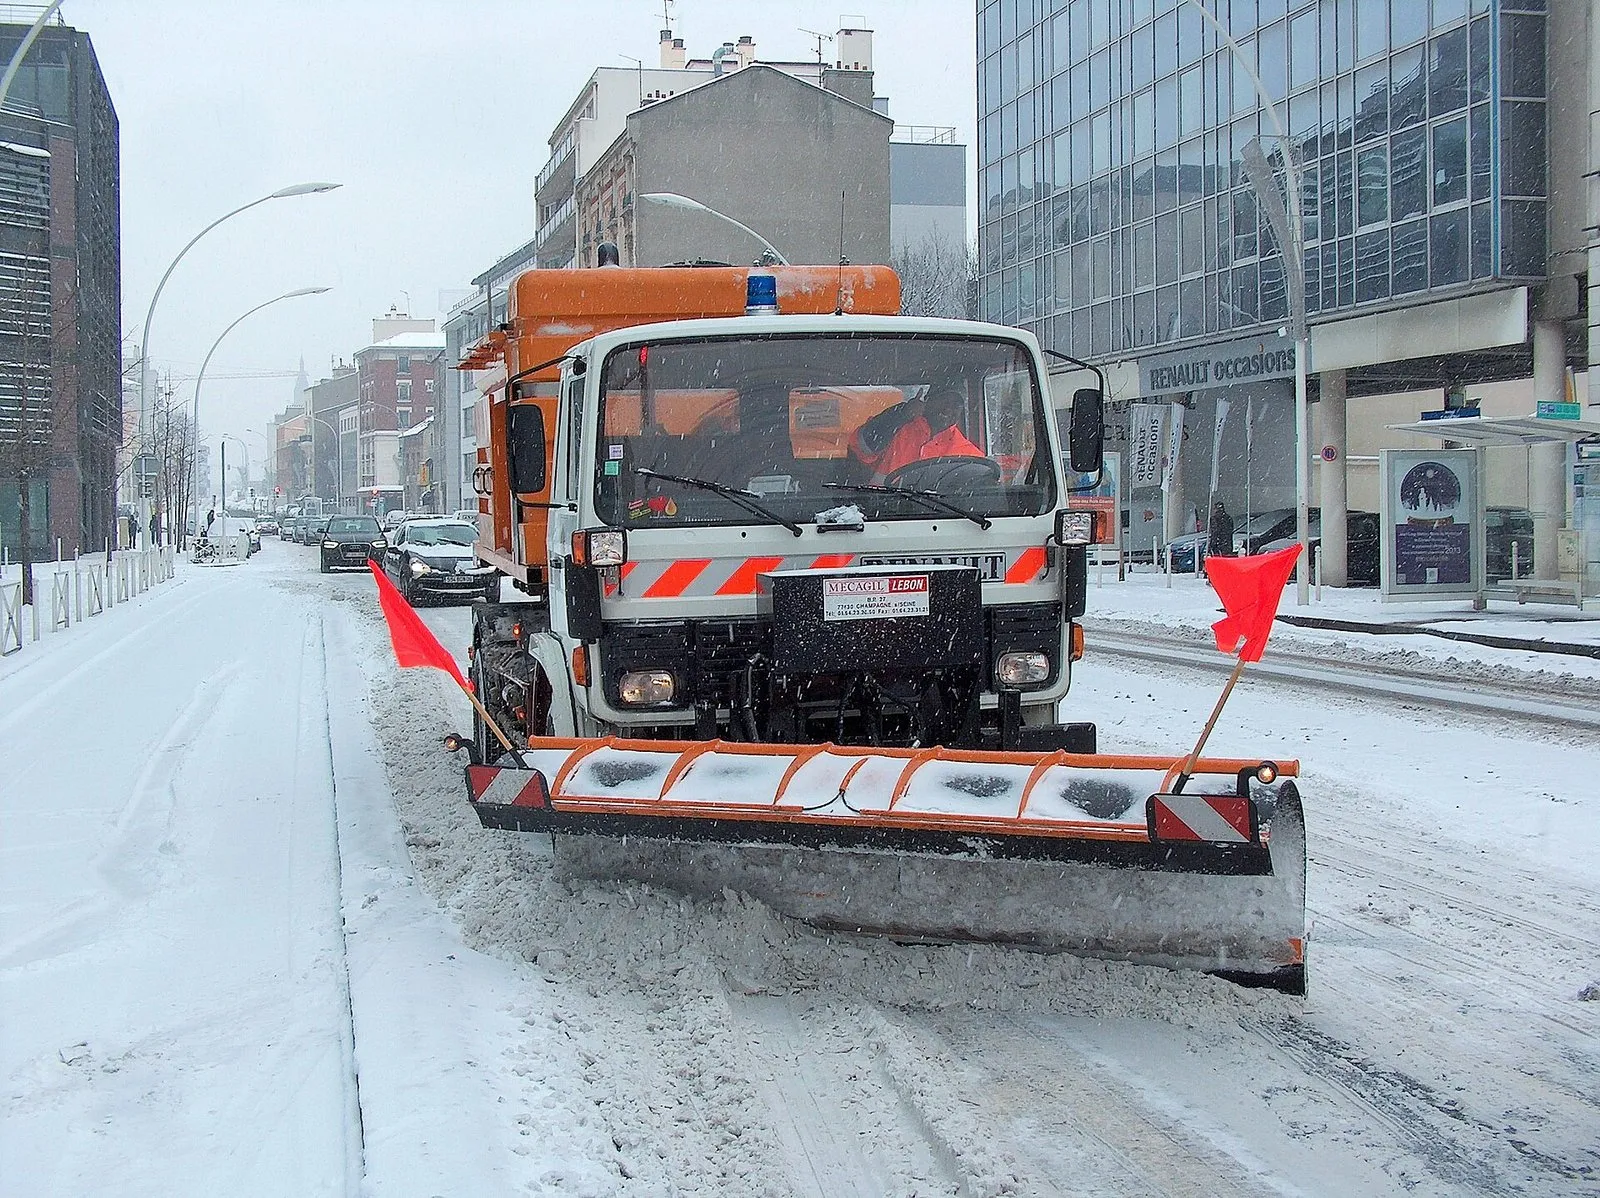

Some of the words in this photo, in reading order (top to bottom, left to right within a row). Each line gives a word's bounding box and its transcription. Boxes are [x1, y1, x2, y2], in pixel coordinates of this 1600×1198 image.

[1150, 359, 1211, 390] RENAULT
[1213, 344, 1295, 381] occasions
[1136, 427, 1147, 482] RENAULT
[1146, 418, 1159, 481] occasions
[829, 581, 884, 593] MECAGIL
[892, 579, 924, 591] LEBON
